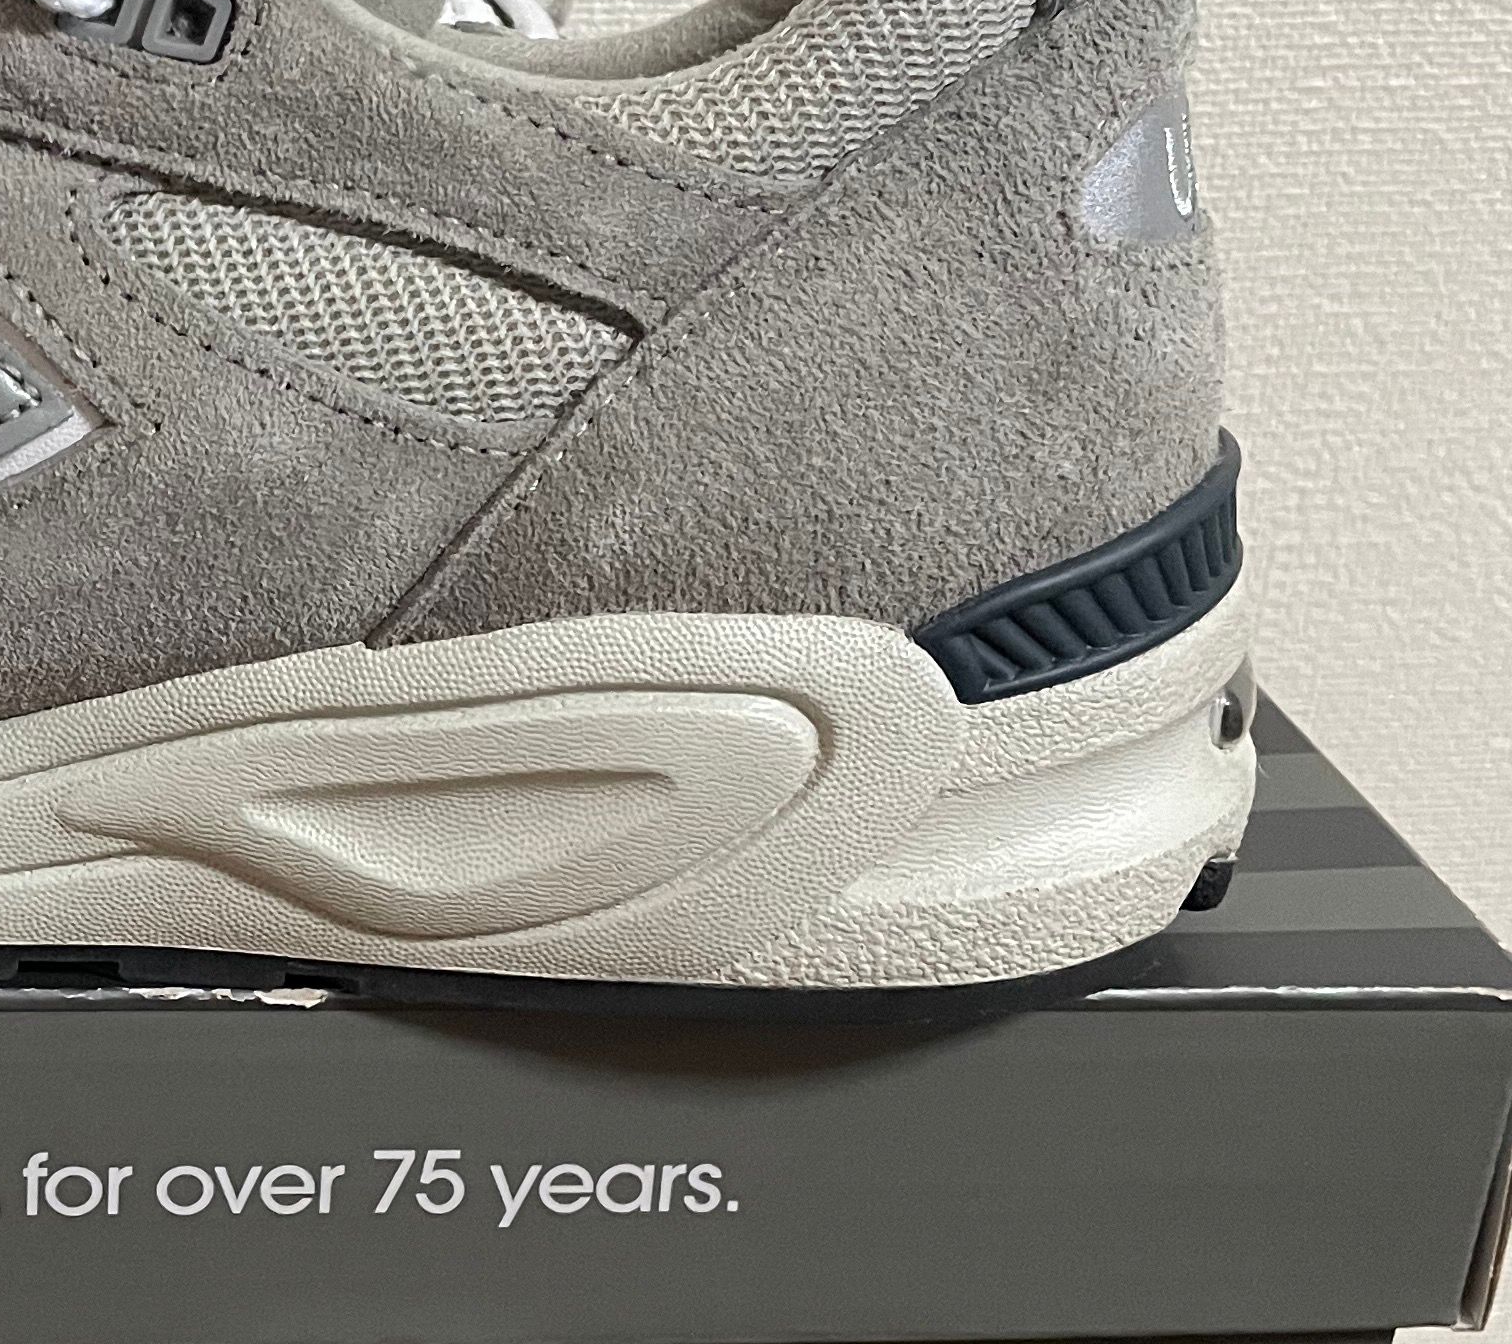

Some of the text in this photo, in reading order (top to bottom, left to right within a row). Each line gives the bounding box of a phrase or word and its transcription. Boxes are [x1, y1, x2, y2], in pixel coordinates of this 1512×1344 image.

[21, 1150, 134, 1218] for
[154, 1163, 347, 1216] over
[372, 1148, 466, 1216] 75
[489, 1162, 740, 1229] years.
